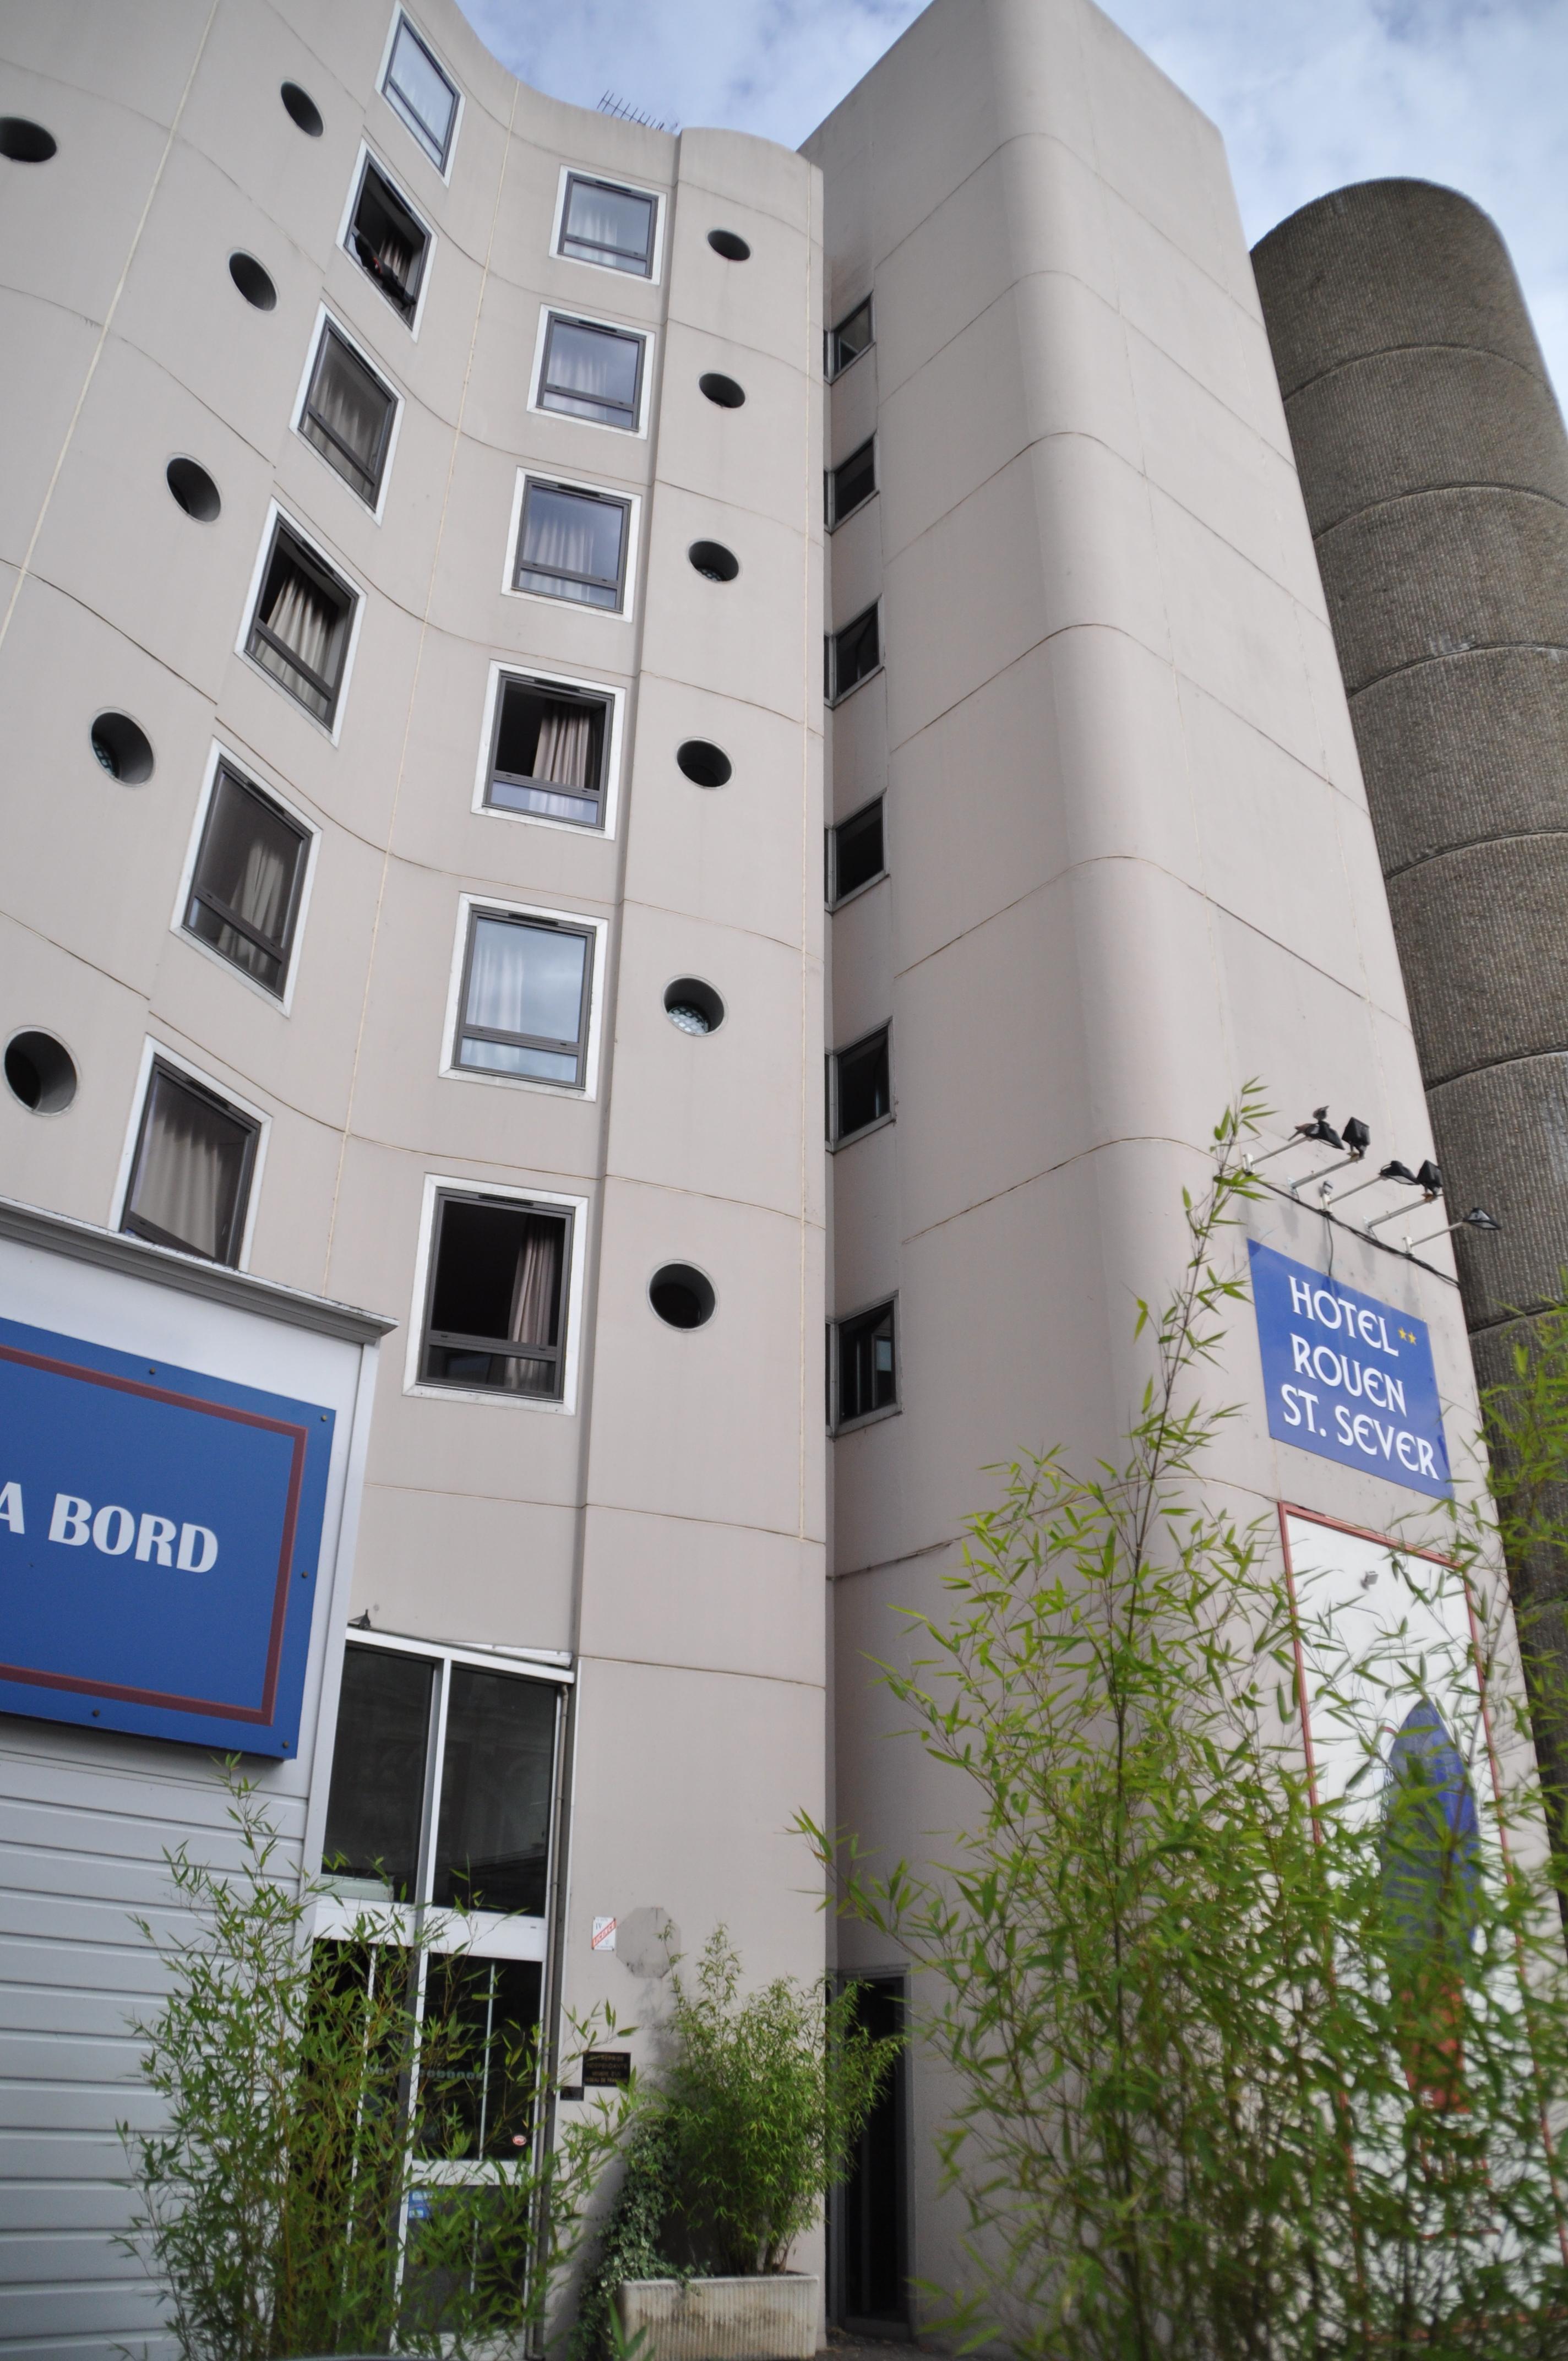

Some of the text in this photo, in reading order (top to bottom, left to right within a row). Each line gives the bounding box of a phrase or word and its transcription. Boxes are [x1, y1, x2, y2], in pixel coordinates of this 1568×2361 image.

[1288, 1275, 1399, 1357] HOTEL
[1291, 1333, 1407, 1417] ROUEN
[1281, 1384, 1440, 1480] ST. SEVER
[48, 1493, 219, 1573] BORD
